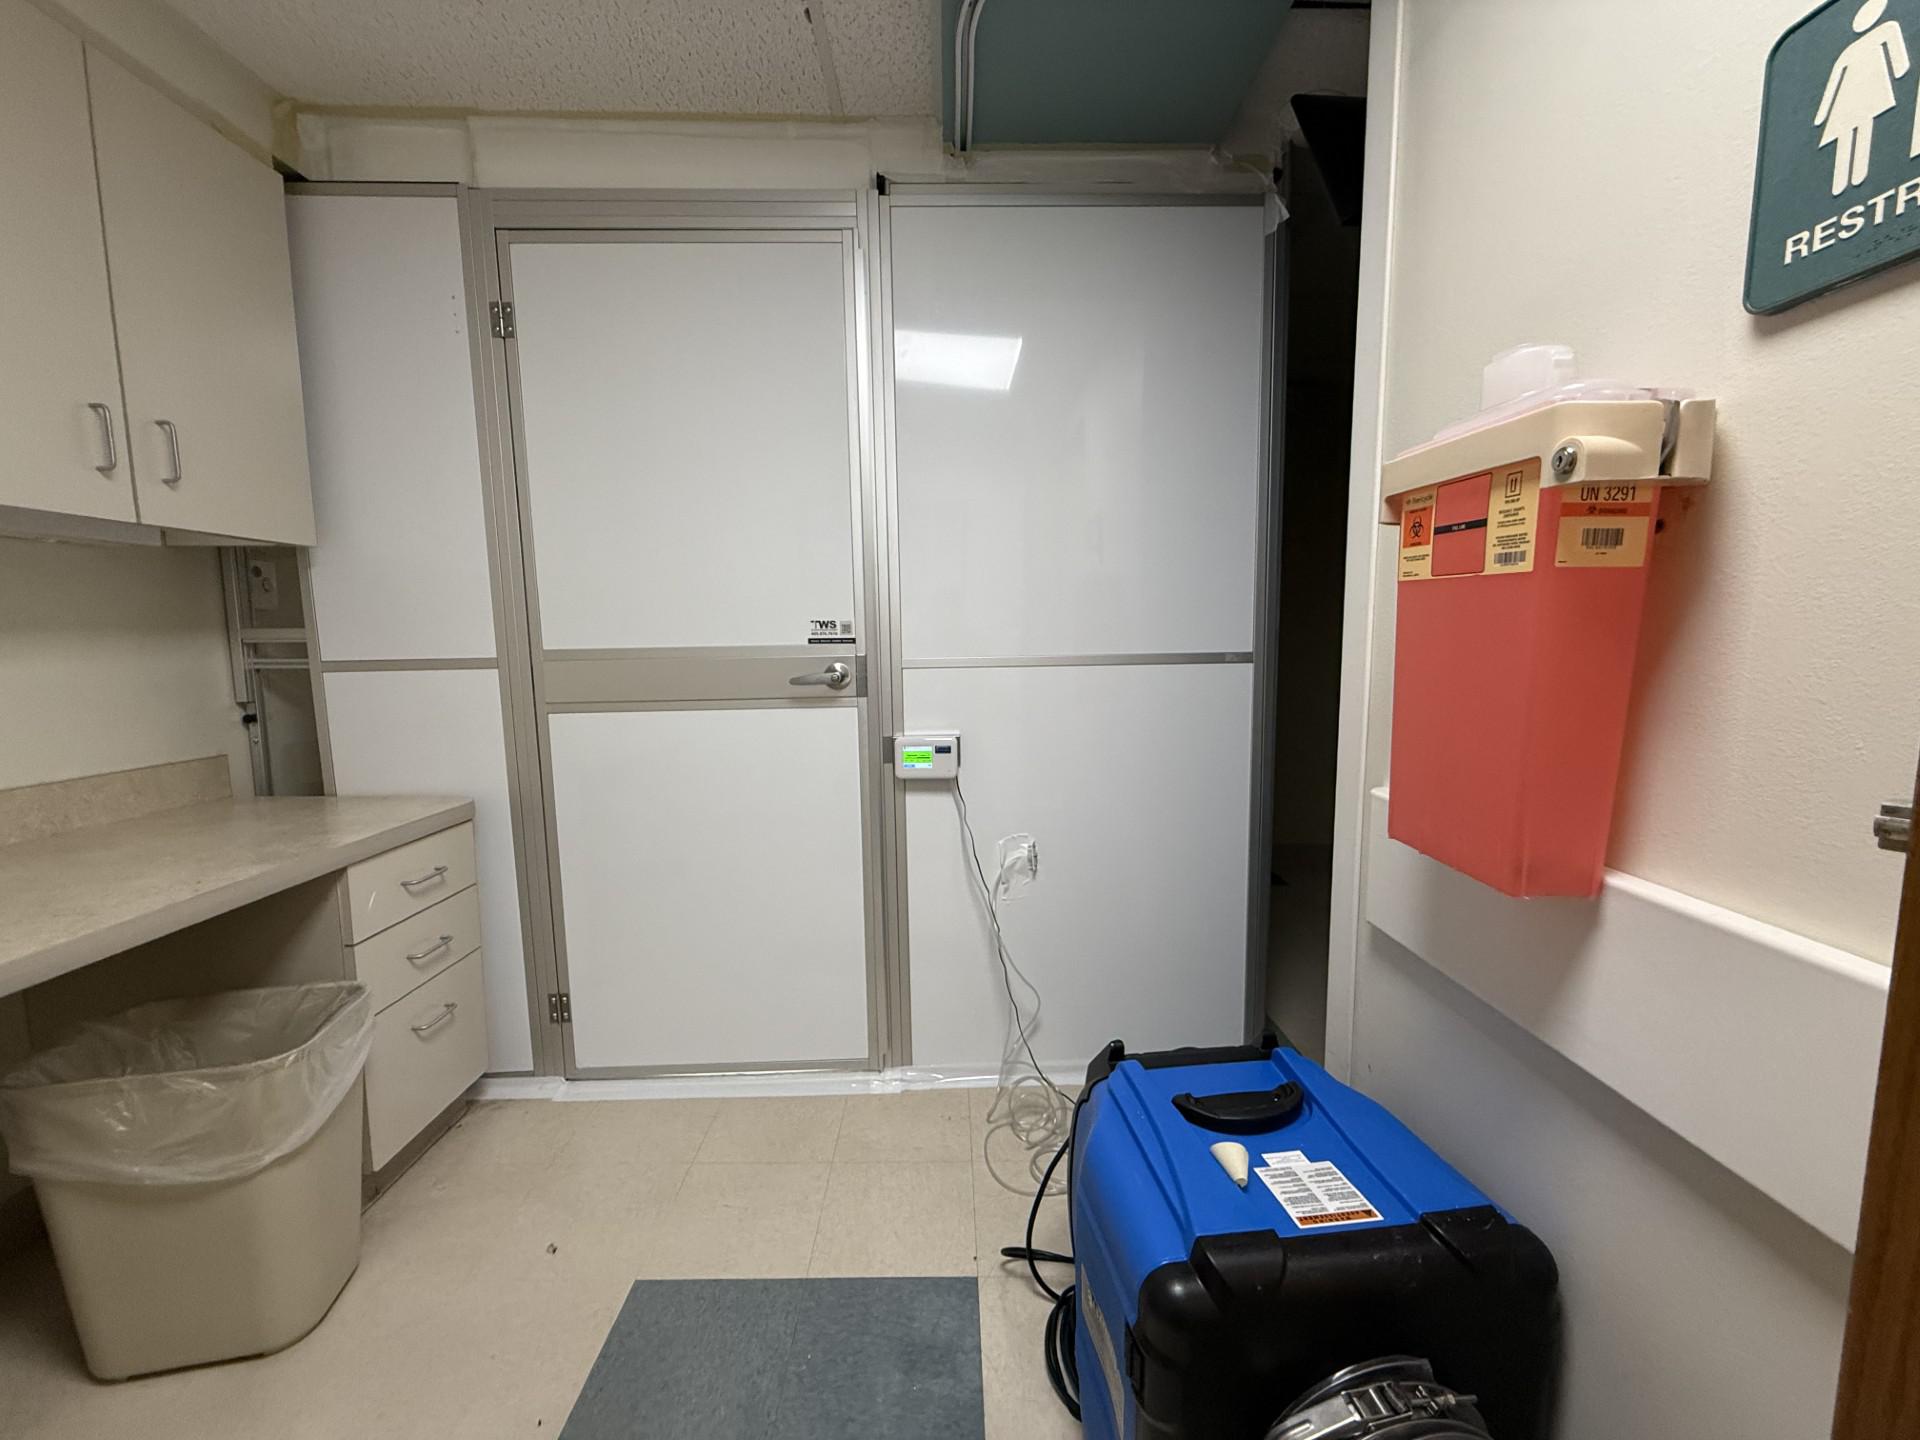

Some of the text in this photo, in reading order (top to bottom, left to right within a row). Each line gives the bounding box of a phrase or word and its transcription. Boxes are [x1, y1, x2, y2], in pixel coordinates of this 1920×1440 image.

[1784, 176, 1920, 265] RESTR
[1580, 486, 1636, 501] UN 3291
